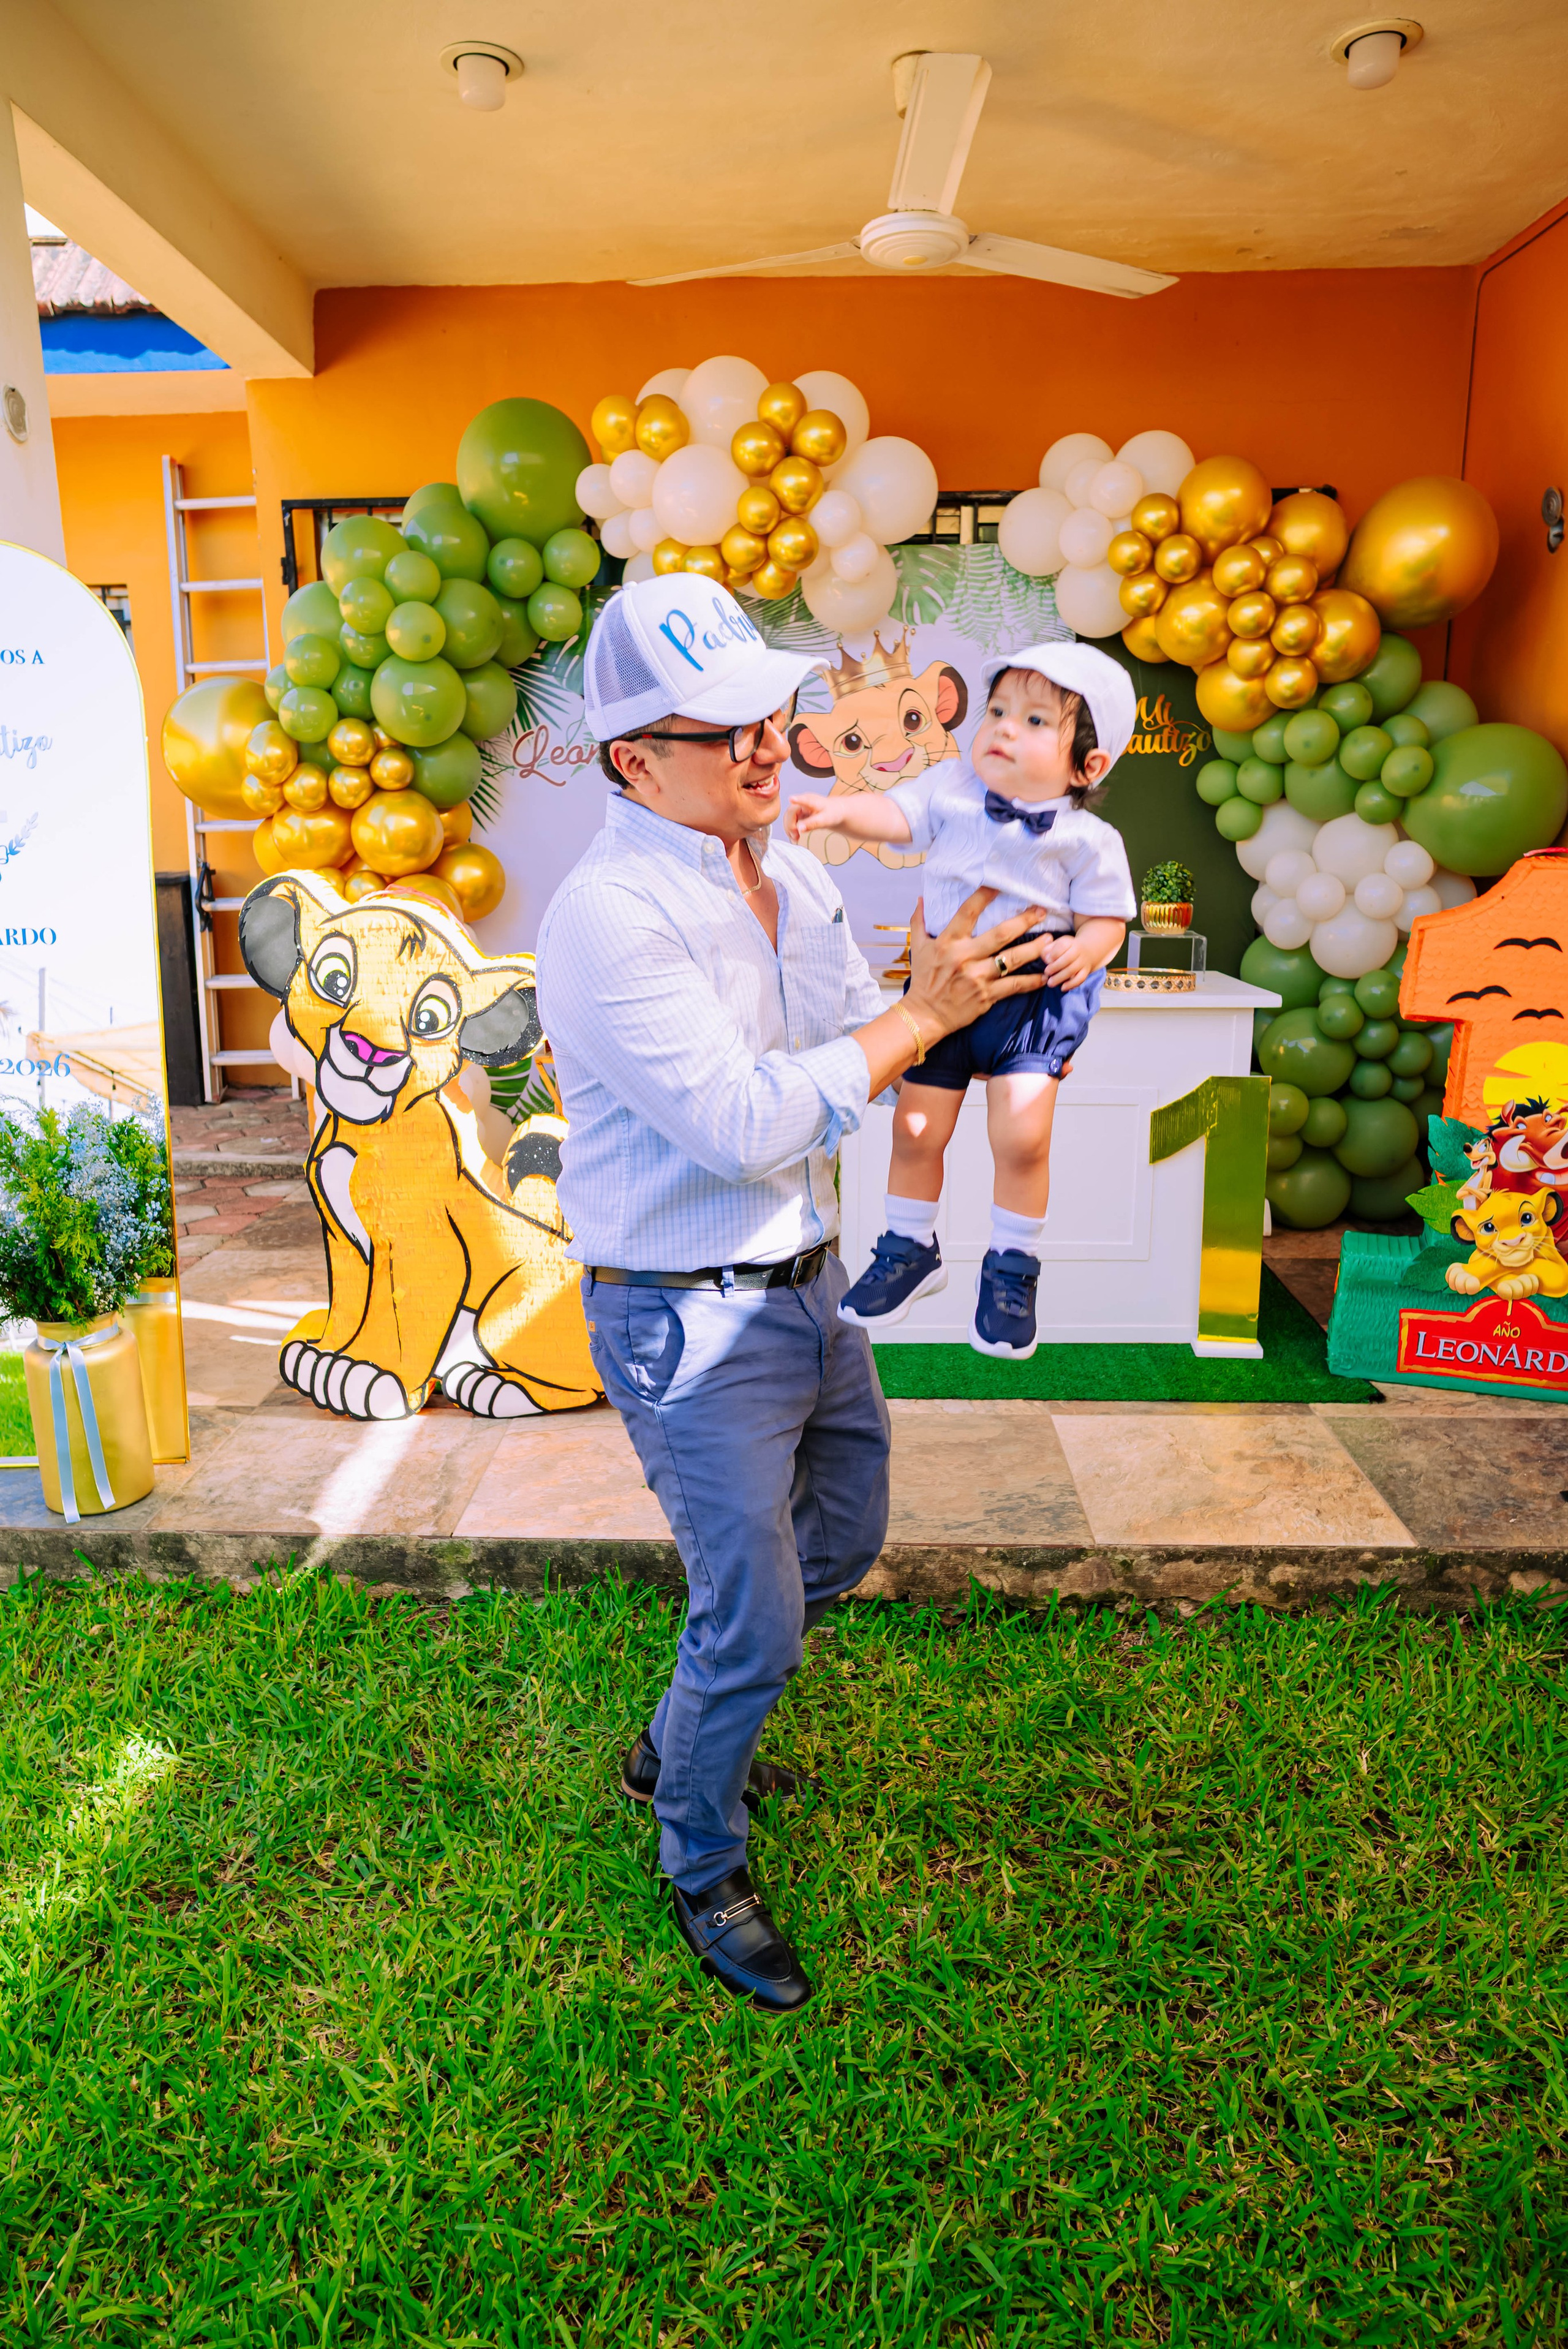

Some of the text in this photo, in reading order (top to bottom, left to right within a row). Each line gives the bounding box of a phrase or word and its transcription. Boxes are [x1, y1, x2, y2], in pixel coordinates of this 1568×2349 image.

[32, 649, 45, 664] A
[0, 725, 53, 769] tizo
[1121, 723, 1212, 766] autizo
[0, 1052, 70, 1077] 2026
[1493, 1321, 1521, 1338] AÑO
[1415, 1331, 1568, 1373] LEONARD
